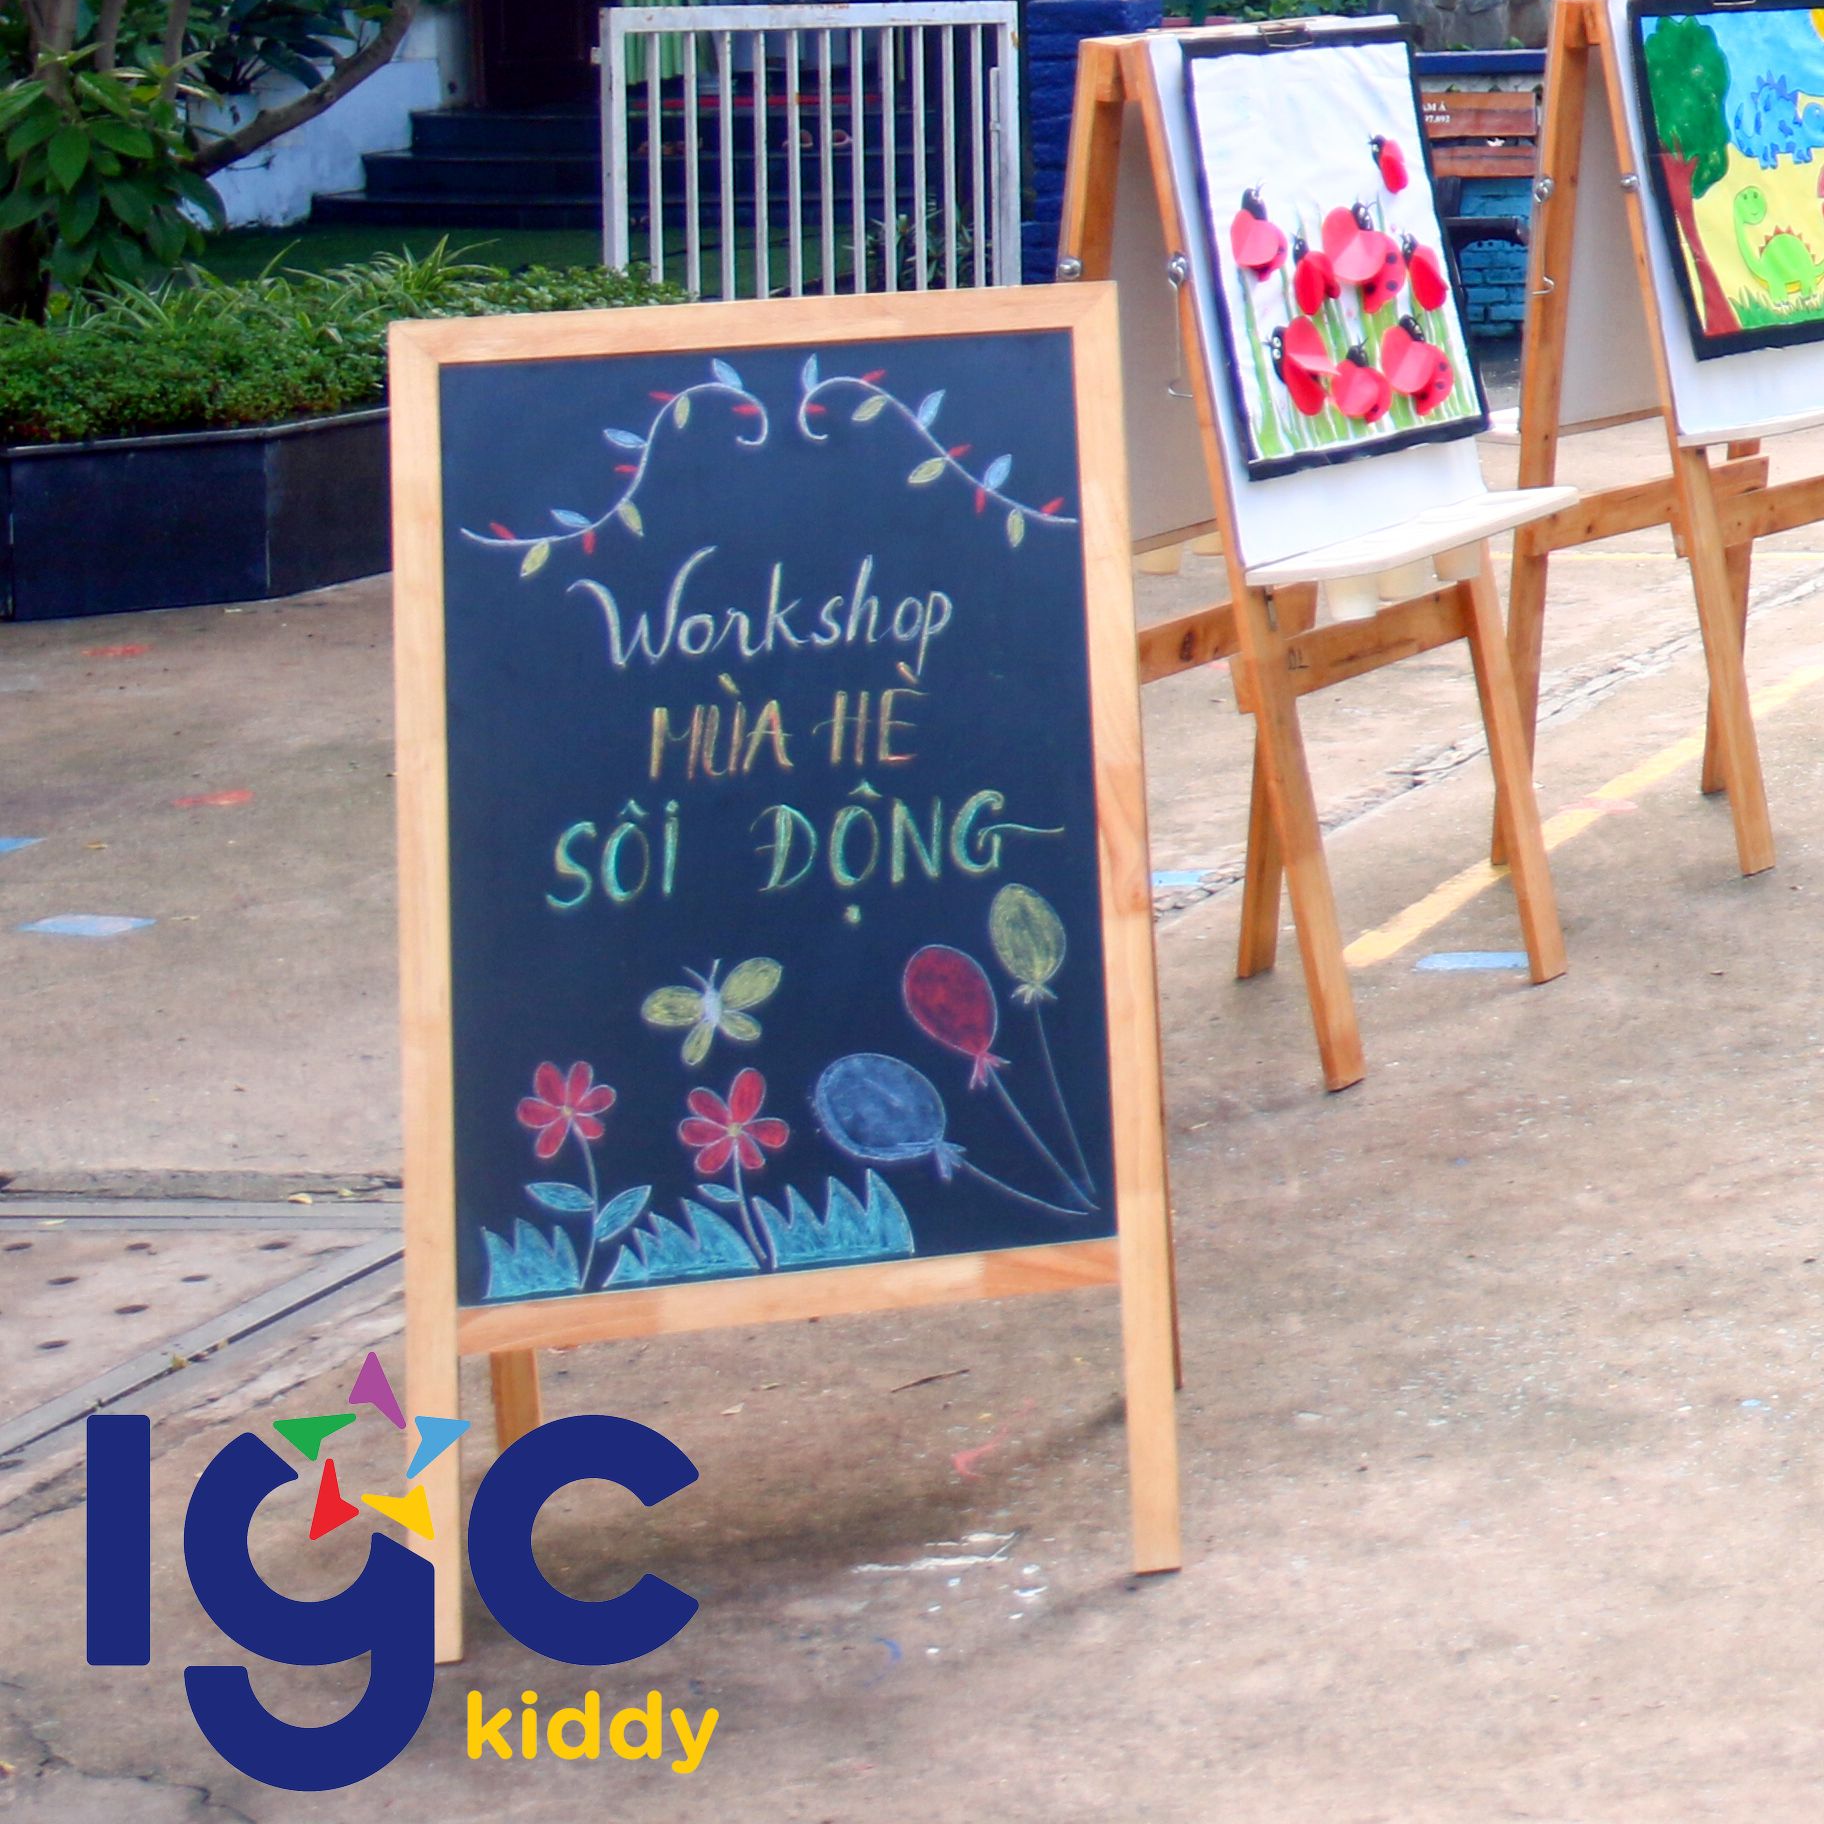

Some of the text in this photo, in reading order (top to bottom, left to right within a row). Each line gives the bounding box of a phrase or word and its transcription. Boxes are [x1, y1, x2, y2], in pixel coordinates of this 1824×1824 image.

[567, 546, 952, 676] Workshop
[650, 662, 930, 779] MÙA HÈ
[750, 781, 1065, 924] ĐỘNG
